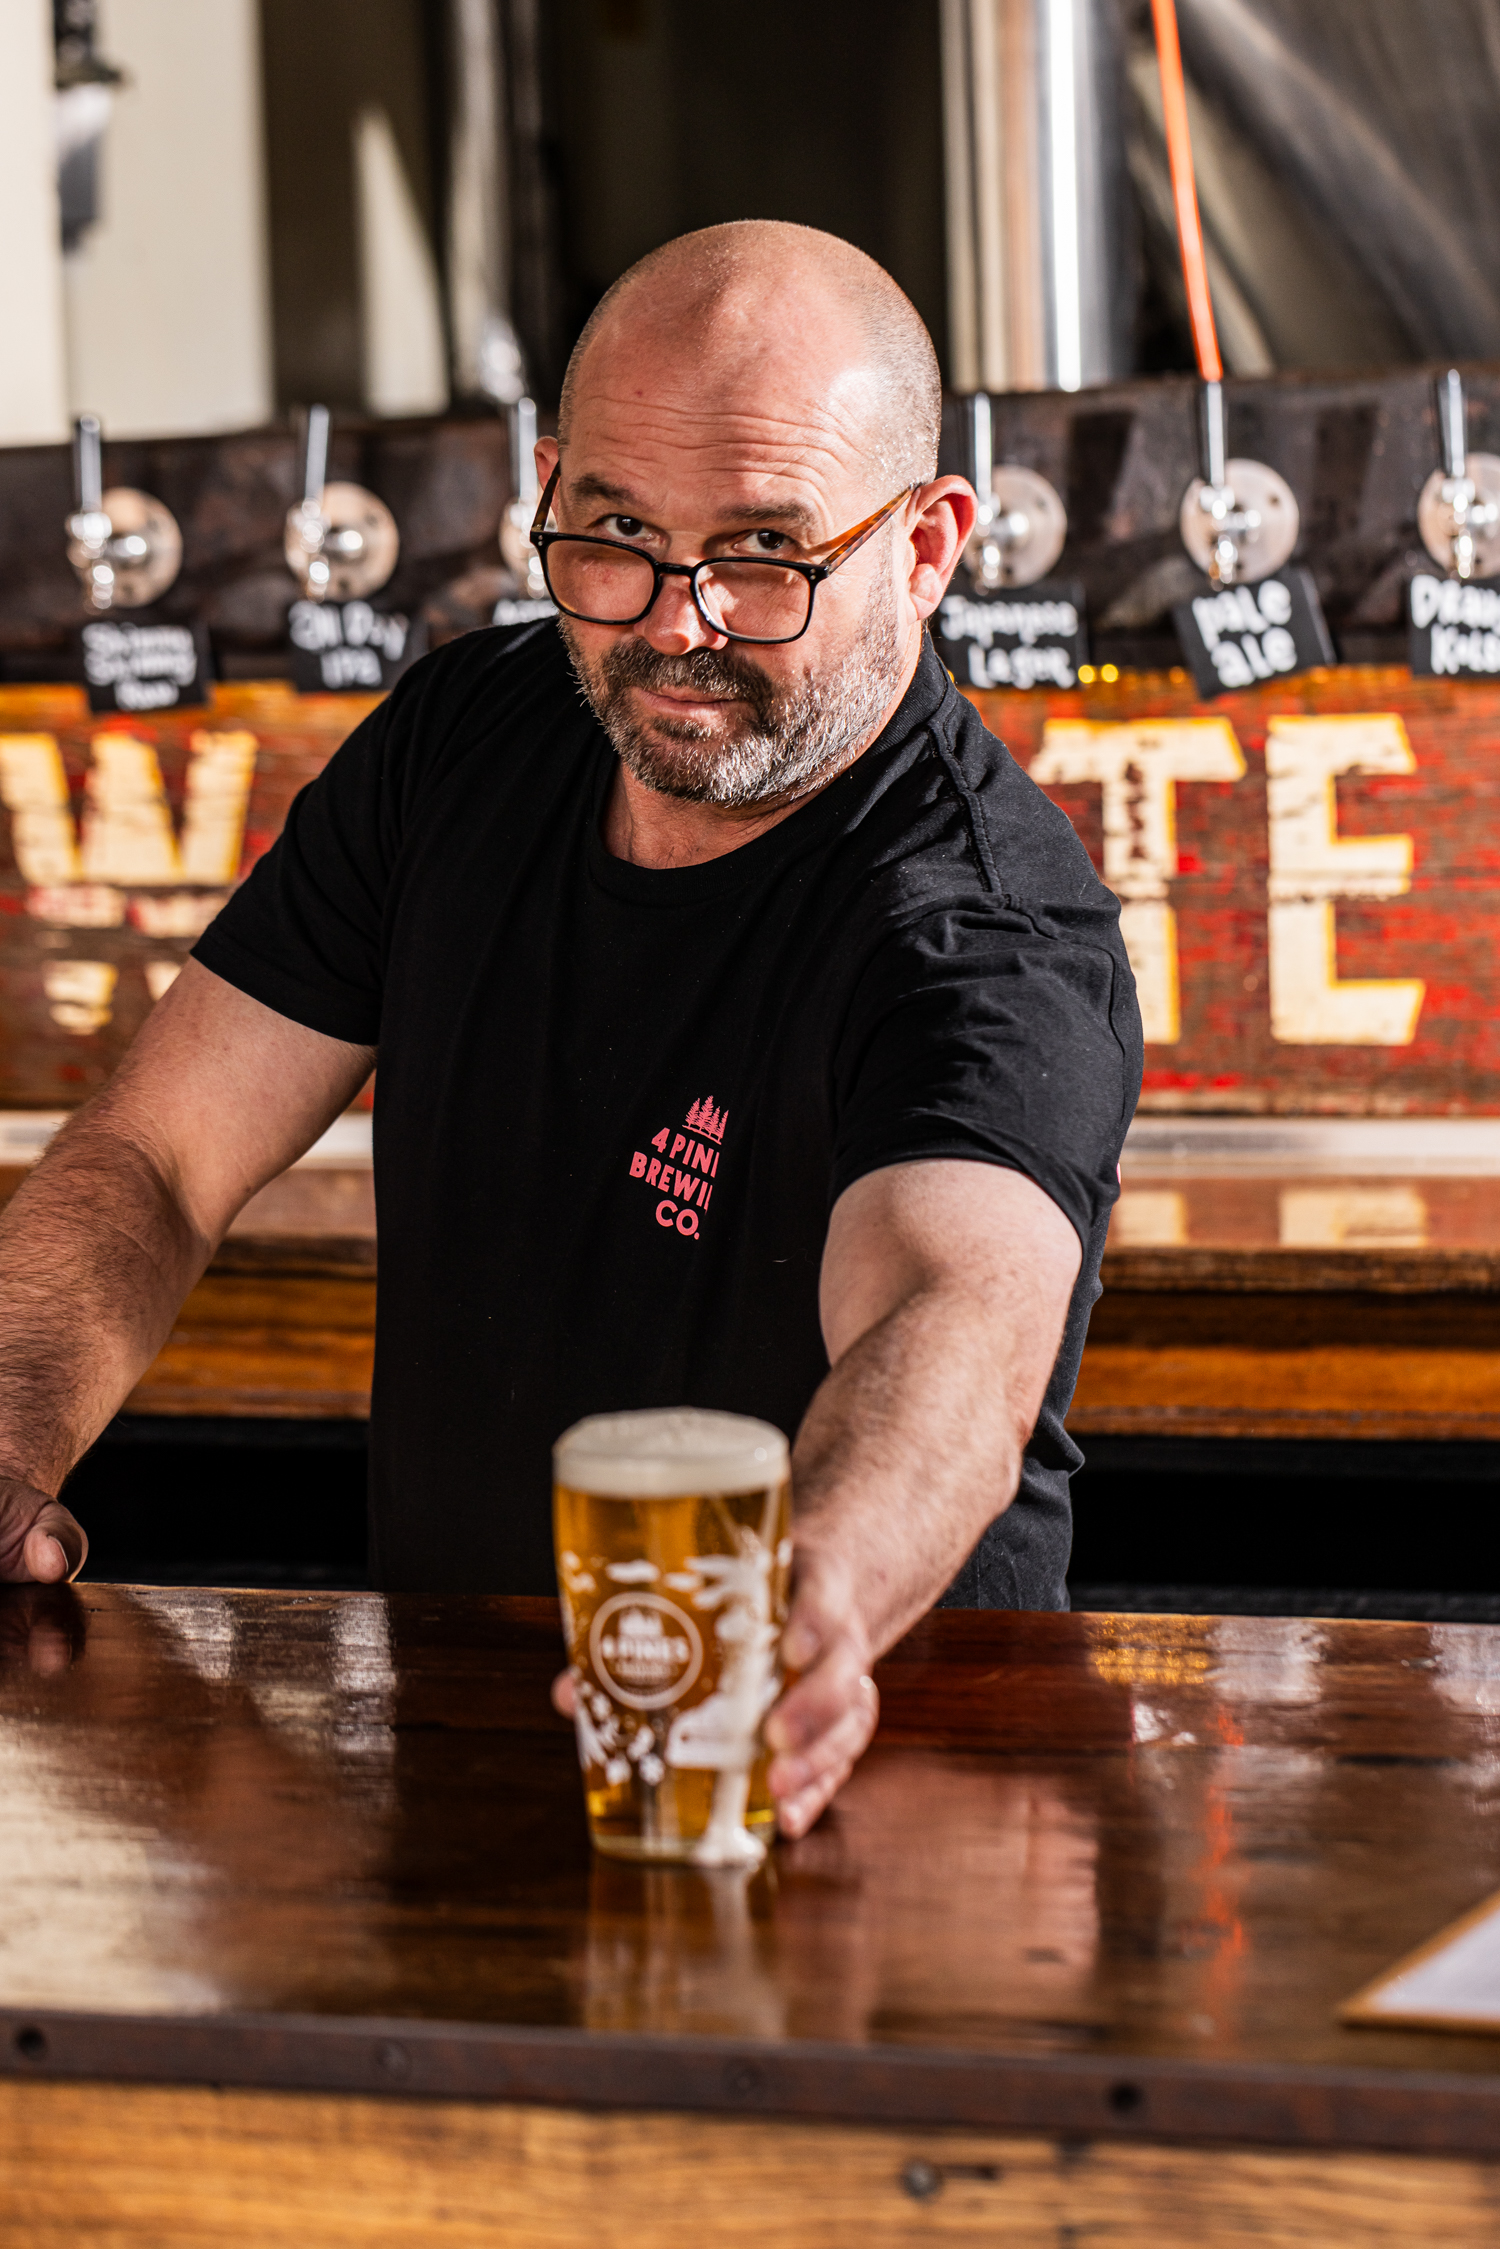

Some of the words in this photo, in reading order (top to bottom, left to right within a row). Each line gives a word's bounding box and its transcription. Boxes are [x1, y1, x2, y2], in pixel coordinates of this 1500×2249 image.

[651, 1127, 670, 1153] 4
[629, 1151, 713, 1213] BREWI
[655, 1200, 700, 1240] CO.
